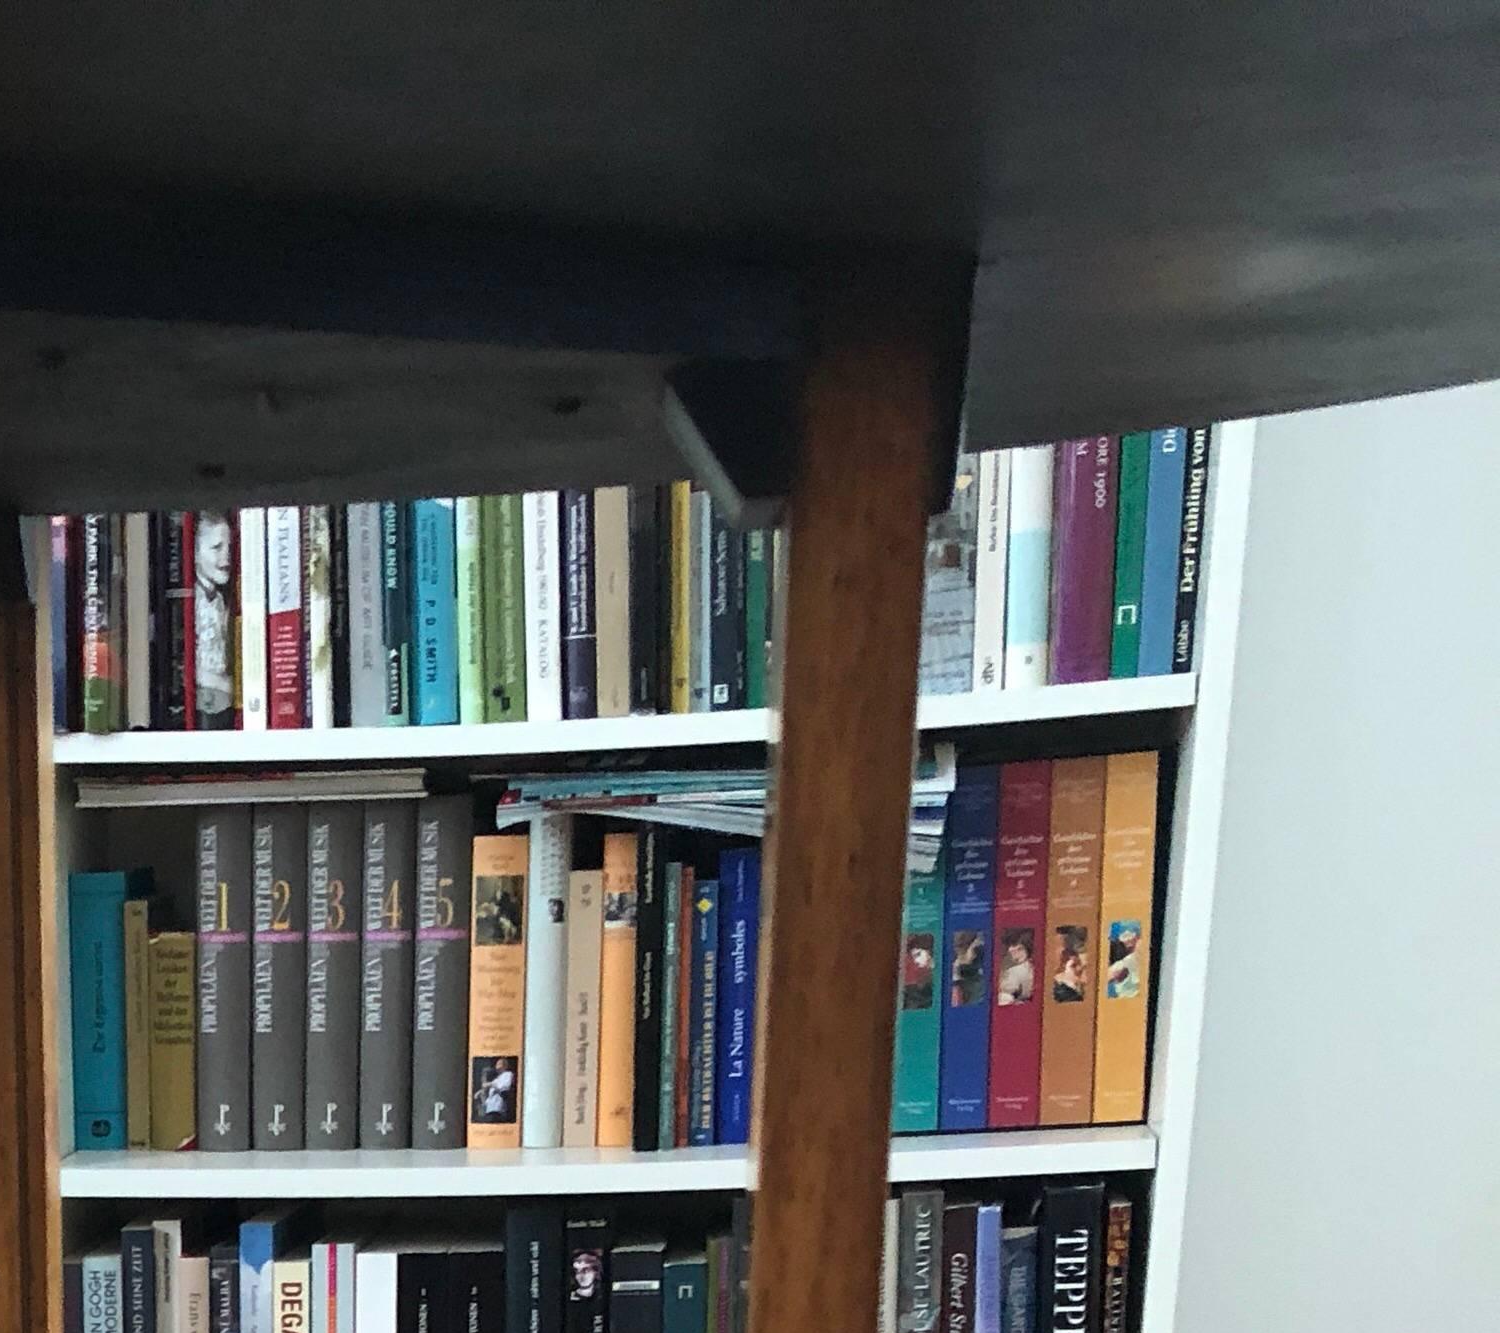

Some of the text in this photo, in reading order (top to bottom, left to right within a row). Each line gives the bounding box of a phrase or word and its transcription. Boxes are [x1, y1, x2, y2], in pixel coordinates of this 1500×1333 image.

[1094, 472, 1105, 509] 1900
[1180, 429, 1206, 593] Der Frühling von
[88, 527, 97, 561] PARK
[88, 568, 97, 595] THE
[278, 527, 290, 604] ITALIANS
[387, 549, 398, 589] KNOW
[426, 638, 438, 683] SMITH
[538, 619, 548, 679] KATALOG
[200, 825, 217, 866] MUSIK
[256, 825, 273, 866] MUSIK
[311, 824, 329, 865] MUSIK
[366, 823, 385, 863] MUSIK
[419, 821, 439, 862] MUSIK
[200, 869, 217, 895] DER
[255, 869, 273, 894] DER
[310, 868, 328, 894] DER
[366, 867, 384, 893] DER
[418, 864, 438, 891] DER
[200, 900, 217, 932] WELT
[219, 882, 229, 931] 1
[255, 897, 272, 931] WELT
[271, 880, 291, 930] 2
[310, 897, 327, 931] WELT
[326, 880, 345, 930] 3
[365, 895, 383, 931] WELT
[382, 880, 402, 930] 4
[418, 894, 437, 928] WELT
[436, 878, 454, 927] 5
[731, 920, 747, 983] symboles
[728, 1008, 745, 1079] La Nature
[131, 1246, 142, 1274] ZEIT
[949, 1251, 969, 1308] Gilbert
[88, 1270, 102, 1318] GOGH
[132, 1277, 143, 1312] SEINE
[189, 1291, 202, 1327] Frans
